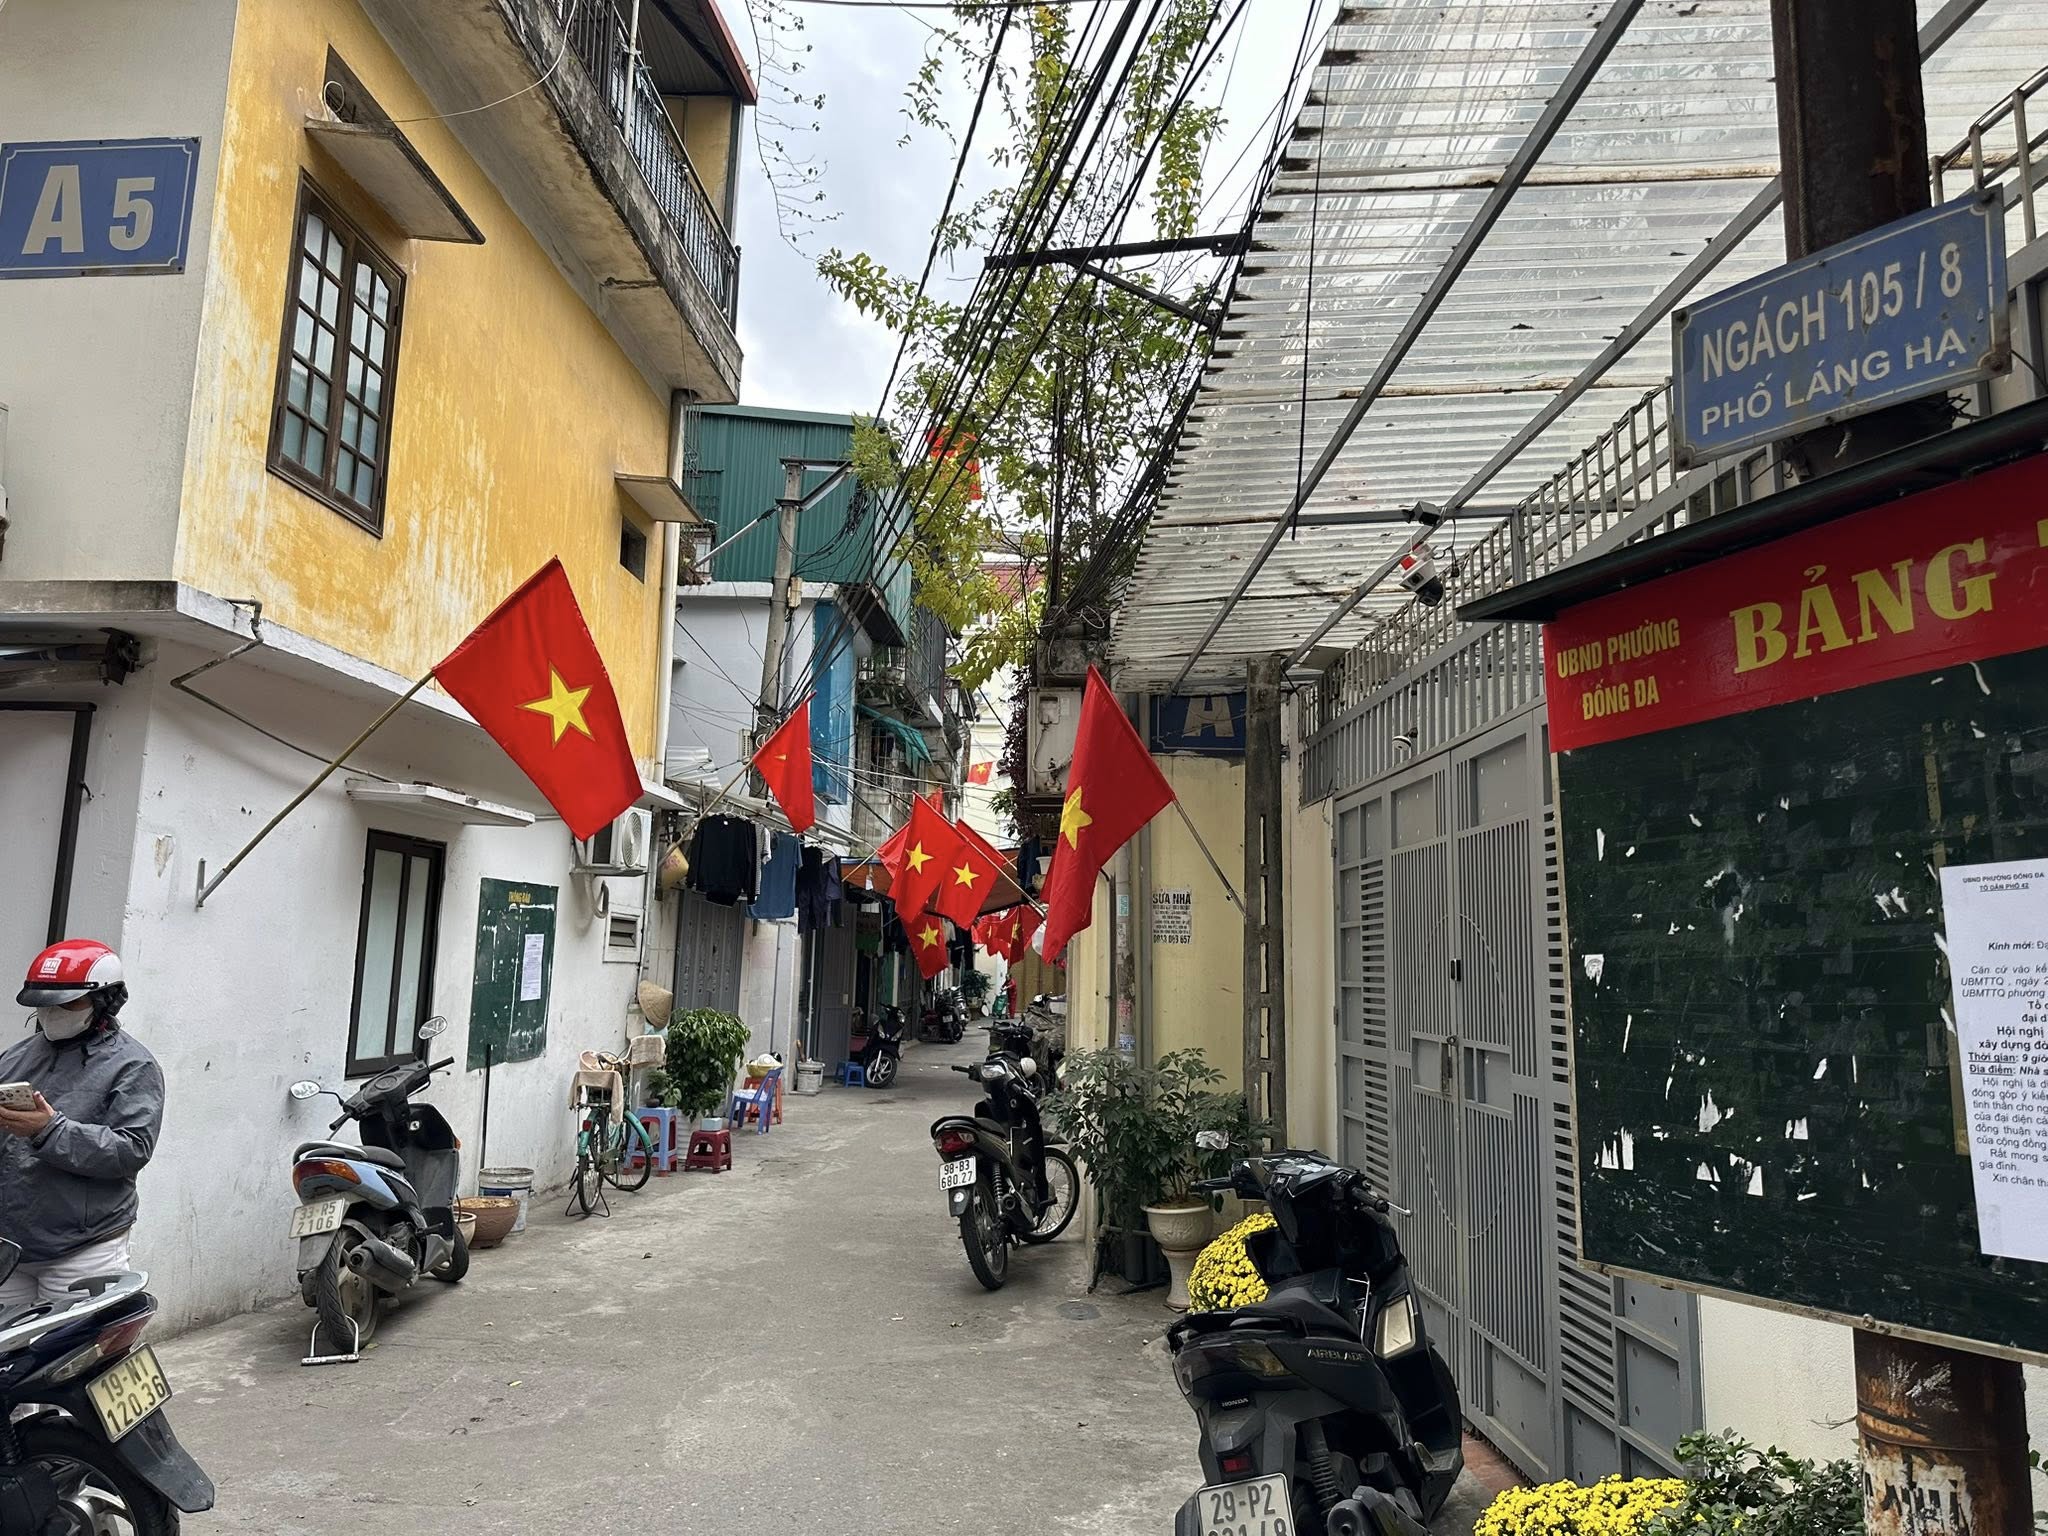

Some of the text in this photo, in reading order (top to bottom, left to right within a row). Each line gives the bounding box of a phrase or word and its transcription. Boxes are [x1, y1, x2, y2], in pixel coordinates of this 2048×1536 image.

[21, 164, 156, 255] A 5
[1702, 289, 1826, 383] NGÁCH
[1840, 262, 1904, 332] 105
[1940, 242, 1963, 299] 8
[1702, 328, 1967, 437] PHỐ LÁNG HẠ
[1729, 536, 1998, 675] BẢNG
[1556, 617, 1681, 679] UBND PHƯỜNG
[1582, 675, 1660, 721] ĐỐNG ĐA
[1183, 695, 1235, 738] A
[1152, 888, 1191, 904] SỬA NHÀ
[1988, 941, 2010, 951] Kính
[2012, 965, 2030, 974] vào
[1961, 977, 2004, 986] UBMTTQ
[2015, 977, 2039, 988] ngày
[1962, 988, 2006, 998] UBMTTQ
[2021, 1013, 2037, 1024] đại
[1996, 1026, 2044, 1038] Hội nghị
[1979, 1039, 1998, 1051] xây
[2001, 1039, 2031, 1052] dựng
[1968, 1051, 1991, 1062] Thời
[2022, 1053, 2029, 1062] 9
[2019, 1065, 2040, 1076] Nhà
[1982, 1077, 1998, 1087] Hội
[2002, 1078, 2023, 1090] nghị
[2016, 1102, 2034, 1112] cho
[1974, 1111, 1991, 1121] của
[1994, 1113, 2009, 1123] đại
[2012, 1113, 2033, 1125] diện
[1975, 1123, 1999, 1135] đồng
[2003, 1124, 2031, 1136] thuận
[1976, 1135, 2047, 1151] của cộng đồng
[2011, 1151, 2038, 1163] mong
[944, 1159, 970, 1175] 98-B3
[1979, 1160, 1993, 1170] gia
[941, 1170, 973, 1189] 680.27
[1992, 1173, 2008, 1183] Xin
[2010, 1175, 2035, 1186] chân
[299, 1201, 337, 1221] 33-R5
[296, 1215, 334, 1235] 2106
[1307, 1348, 1366, 1361] AIRBLADE
[101, 1354, 149, 1403] 19-N1
[107, 1374, 166, 1433] 120.36
[1221, 1397, 1249, 1408] HONDA
[1210, 1482, 1276, 1525] 29-P2
